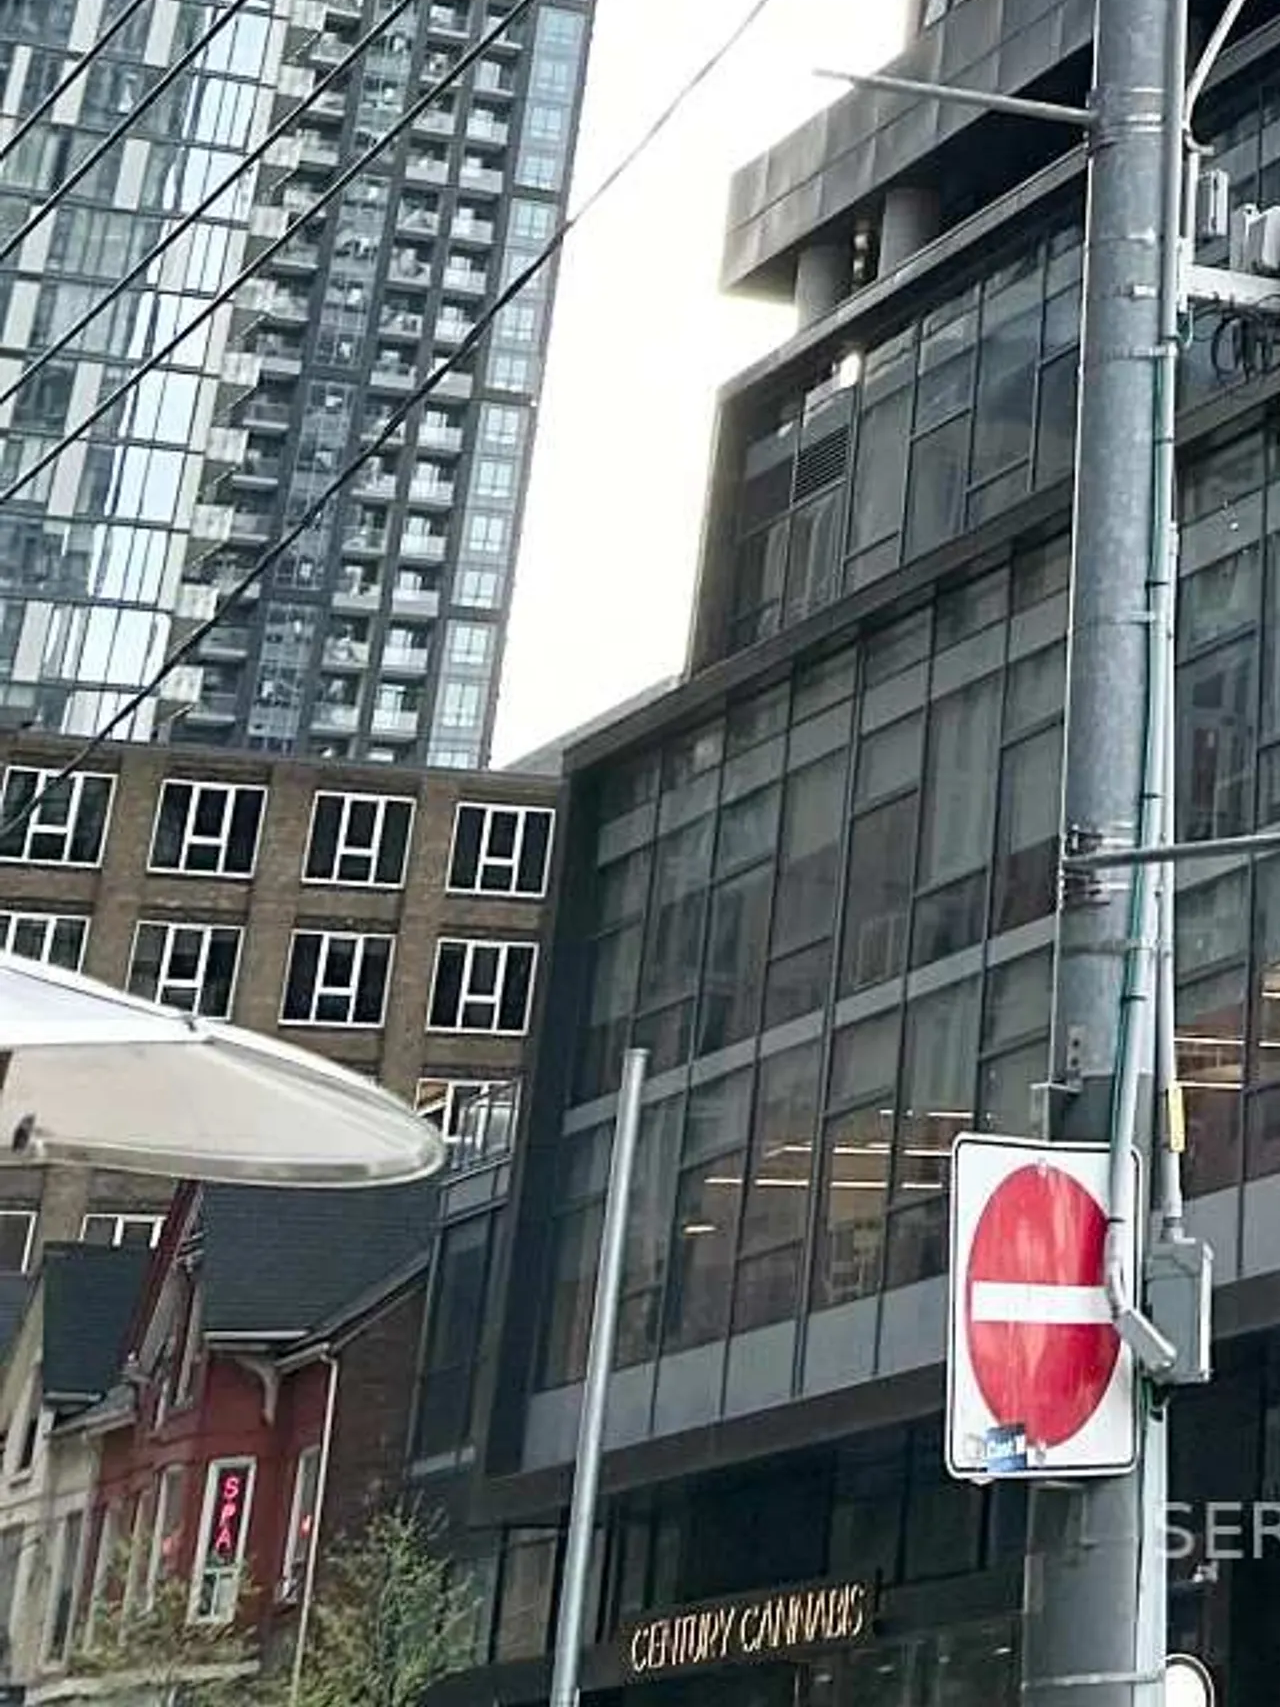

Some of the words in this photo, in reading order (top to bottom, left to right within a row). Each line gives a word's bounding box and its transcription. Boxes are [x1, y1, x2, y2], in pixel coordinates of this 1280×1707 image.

[215, 1476, 240, 1550] SPA
[631, 1606, 737, 1673] CENTURY
[740, 1583, 865, 1653] CANNABIS
